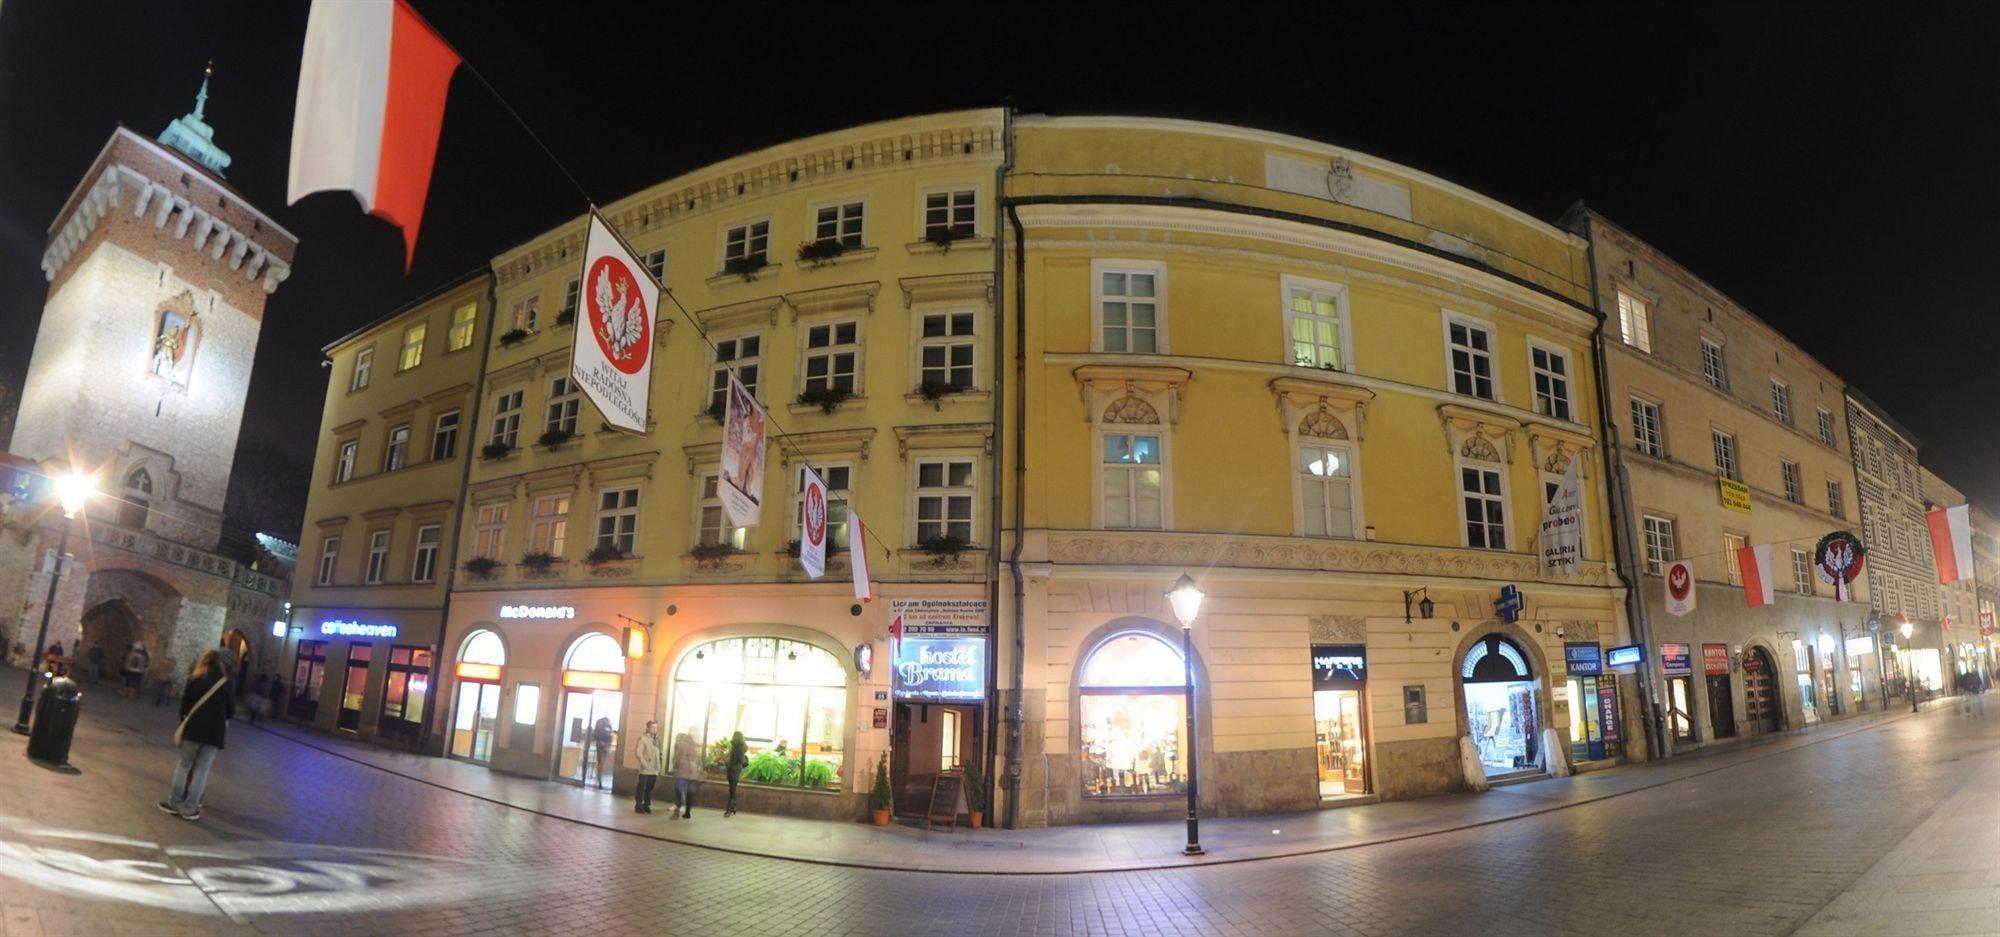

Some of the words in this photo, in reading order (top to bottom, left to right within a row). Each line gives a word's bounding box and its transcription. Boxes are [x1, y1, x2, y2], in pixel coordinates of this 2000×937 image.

[593, 367, 632, 406] RADOSNA
[601, 361, 627, 389] WITAJ
[1543, 515, 1575, 531] probeo
[920, 645, 977, 665] hostel
[1570, 662, 1597, 671] KANTOR
[899, 661, 975, 686] Brama
[1603, 698, 1614, 731] CHANGE
